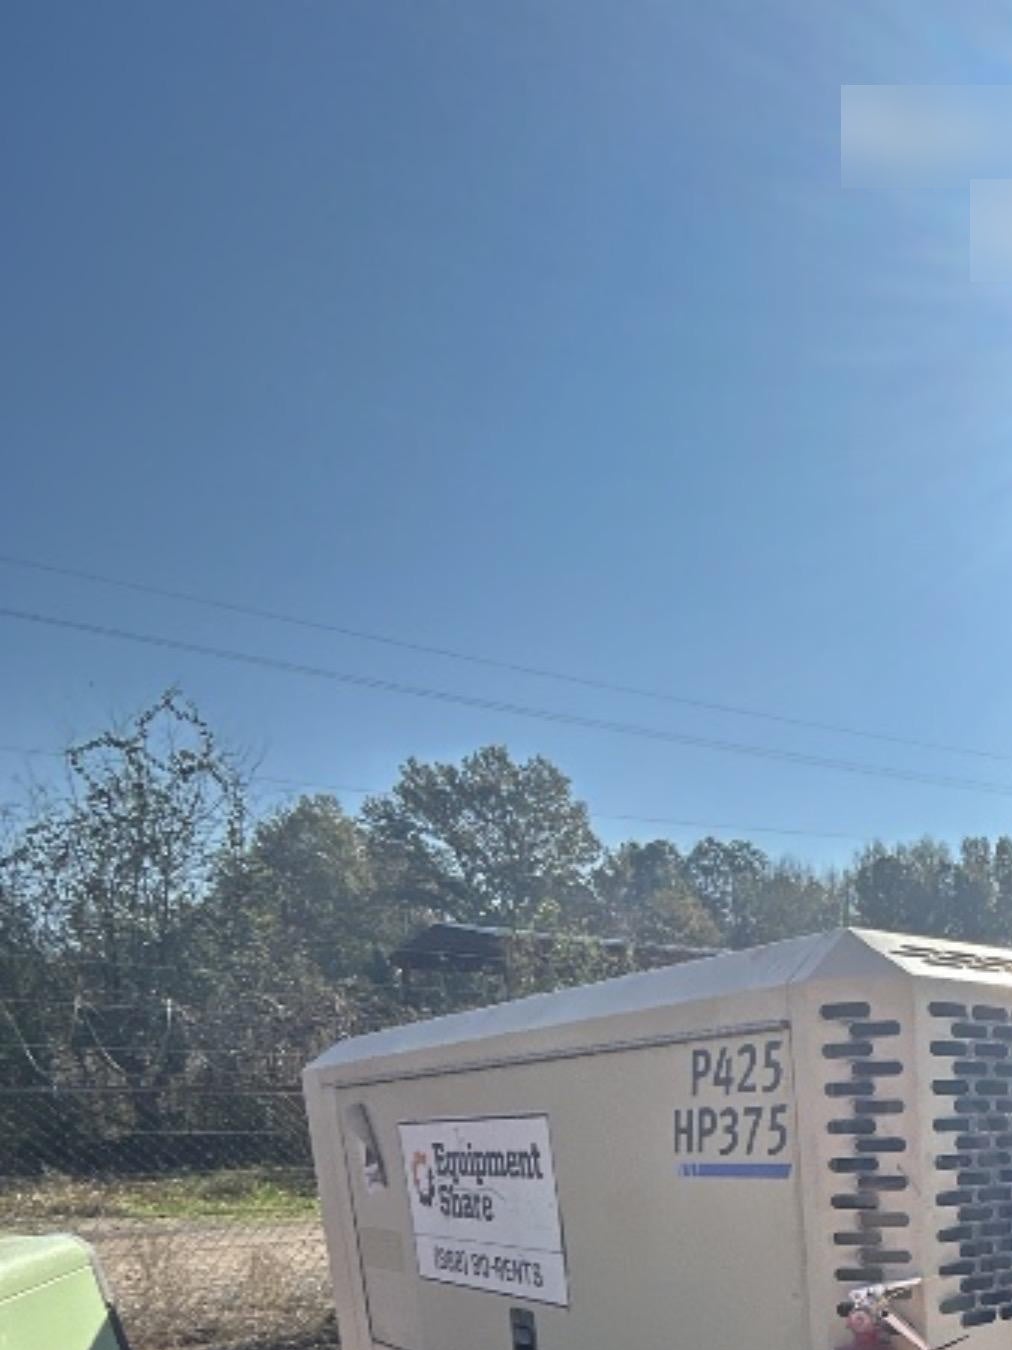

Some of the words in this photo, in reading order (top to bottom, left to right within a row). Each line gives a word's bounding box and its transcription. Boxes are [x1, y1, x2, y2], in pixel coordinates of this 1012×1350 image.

[692, 1040, 783, 1096] P425
[674, 1103, 788, 1156] HP375
[431, 1142, 543, 1186] Equipment
[437, 1184, 494, 1222] Share
